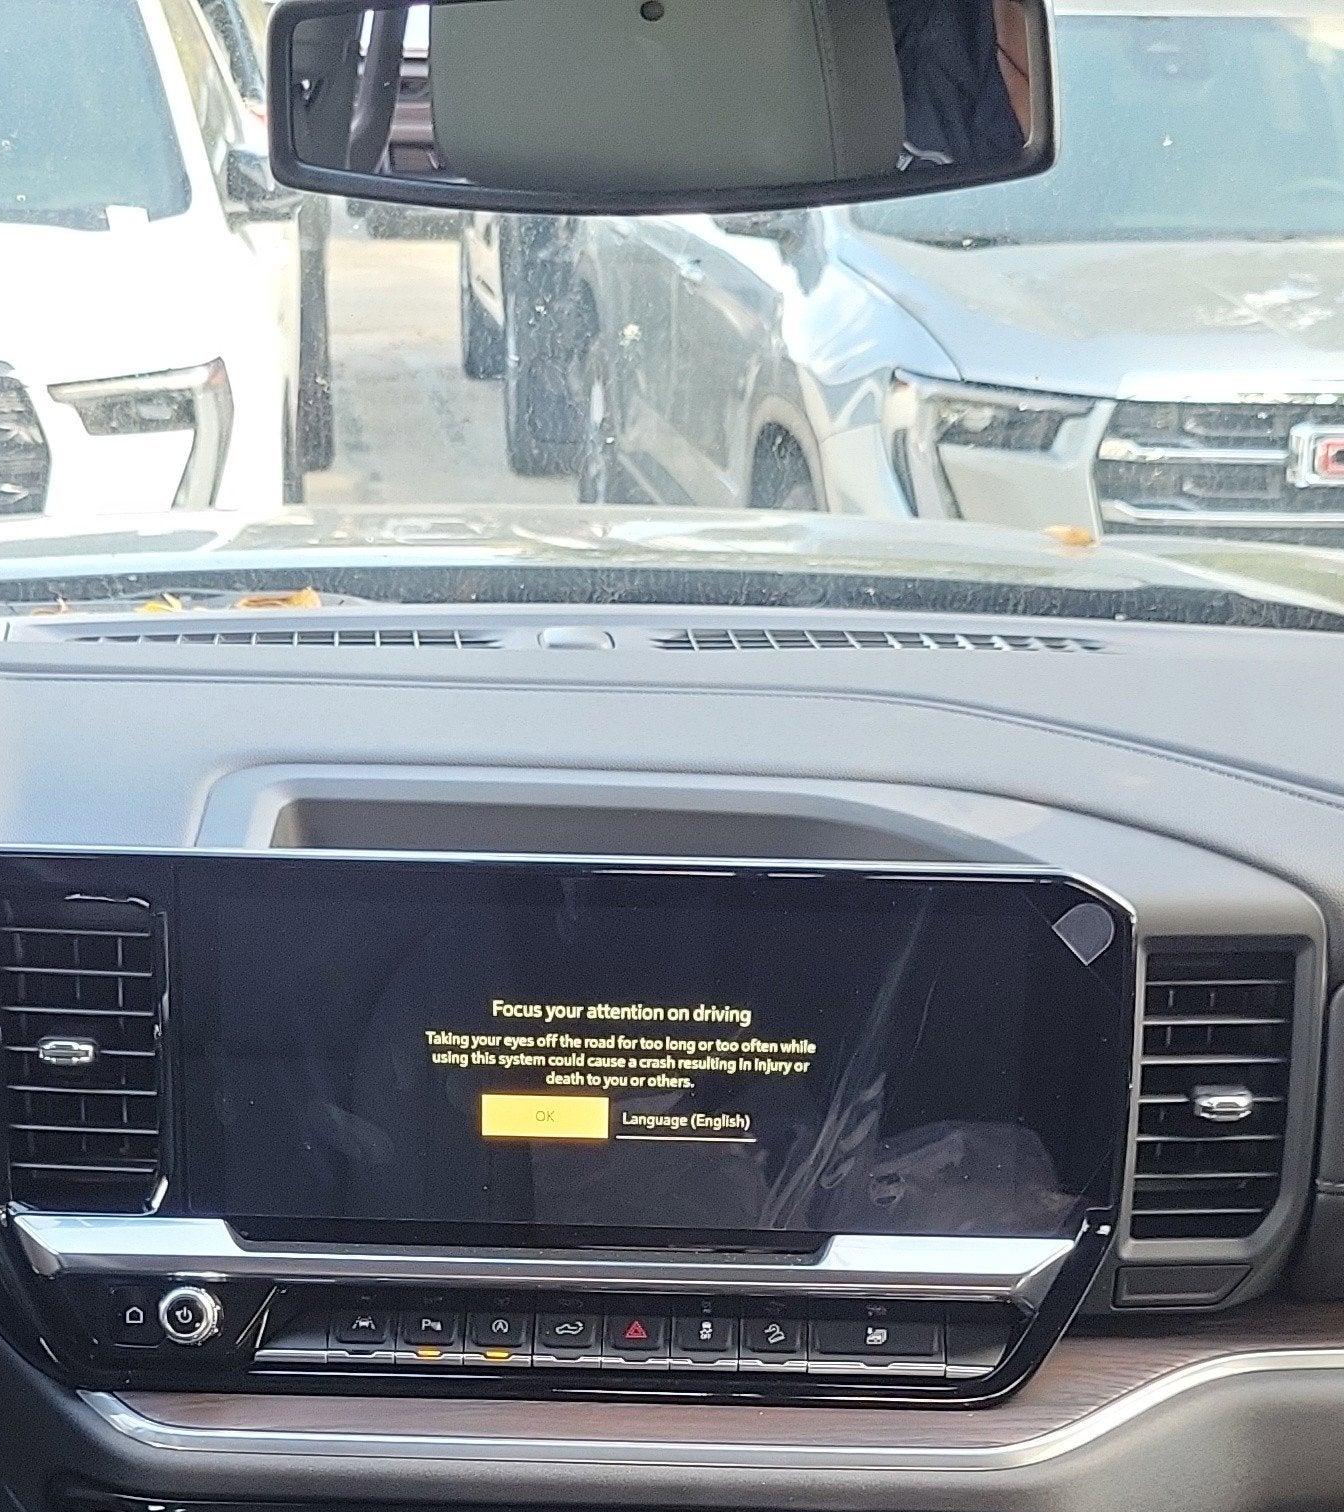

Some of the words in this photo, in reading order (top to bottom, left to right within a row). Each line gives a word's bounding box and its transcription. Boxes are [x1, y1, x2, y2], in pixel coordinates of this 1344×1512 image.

[492, 1000, 542, 1018] Focus
[545, 1006, 584, 1022] your
[587, 1003, 664, 1021] attention
[667, 1007, 689, 1021] on
[693, 1004, 751, 1027] driving
[426, 1031, 469, 1048] Taking
[471, 1036, 502, 1049] your
[504, 1037, 534, 1049] eyes
[537, 1034, 558, 1047] off
[559, 1034, 581, 1048] the
[585, 1035, 615, 1049] road
[618, 1036, 638, 1049] for
[640, 1038, 663, 1050] too
[666, 1037, 696, 1054] long
[698, 1041, 714, 1051] or
[716, 1039, 739, 1051] too
[741, 1038, 778, 1053] often
[780, 1039, 816, 1054] while
[432, 1051, 468, 1067] using
[471, 1052, 496, 1065] this
[498, 1054, 545, 1067] system
[548, 1053, 585, 1067] could
[587, 1056, 626, 1068] cause
[628, 1058, 637, 1068] a
[639, 1055, 675, 1069] crash
[678, 1056, 736, 1074] resulting
[739, 1058, 751, 1071] in
[755, 1058, 792, 1075] injury
[794, 1061, 810, 1072] or
[546, 1072, 584, 1085] death
[587, 1074, 601, 1085] to
[603, 1076, 627, 1089] you
[630, 1076, 646, 1087] or
[647, 1074, 695, 1088] others.
[536, 1111, 555, 1122] OK
[623, 1112, 688, 1129] Language
[691, 1114, 751, 1131] (English)
